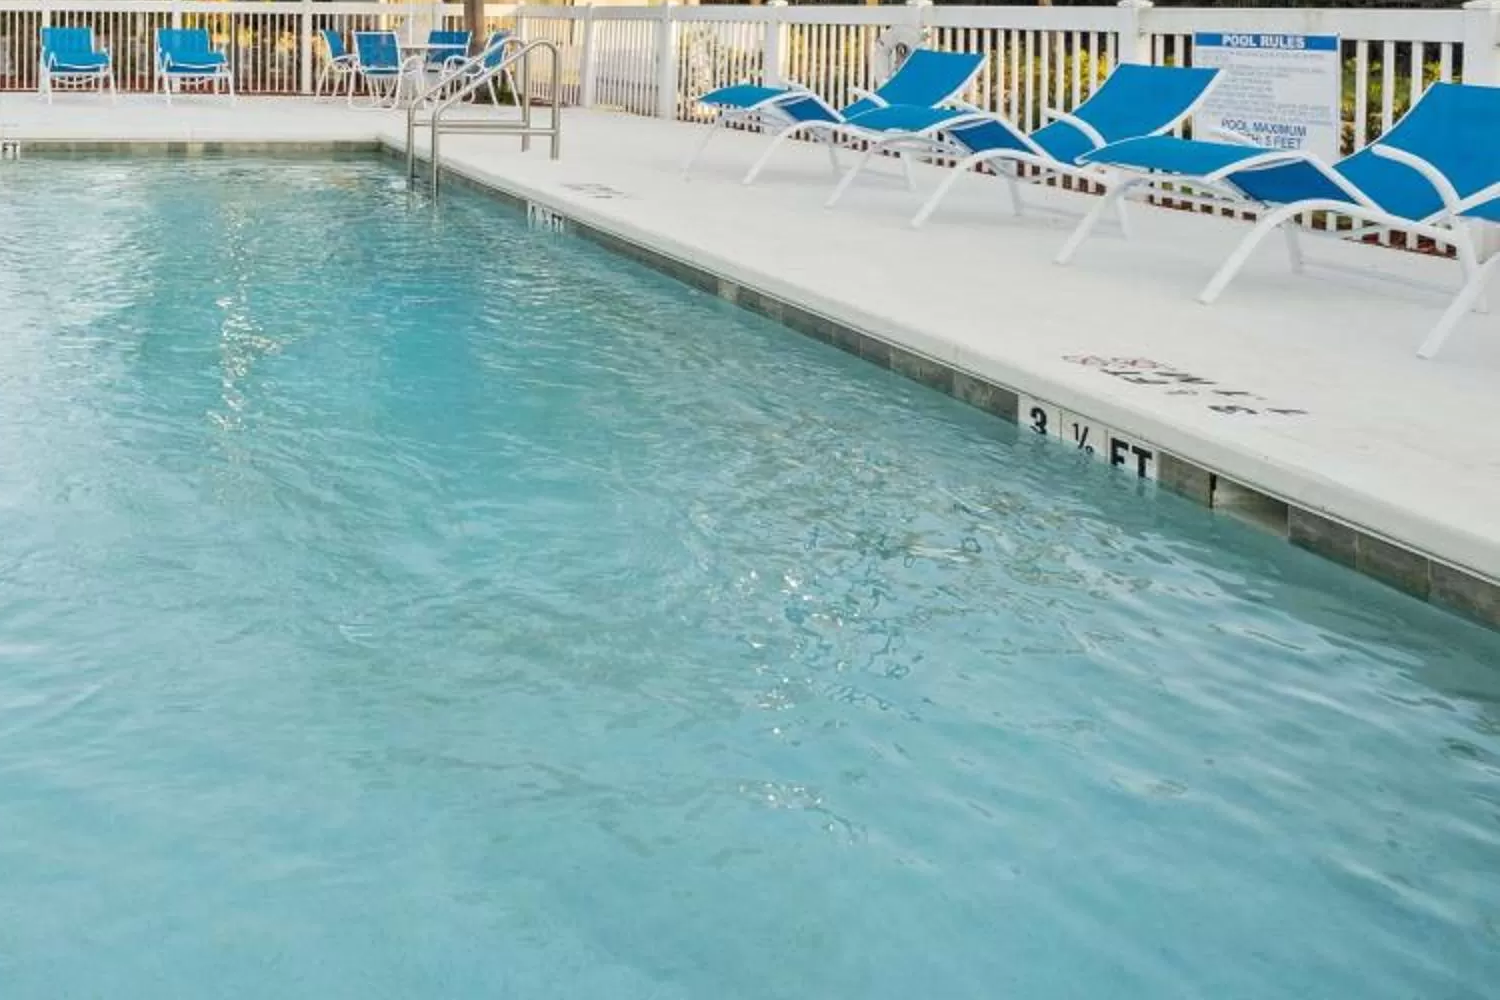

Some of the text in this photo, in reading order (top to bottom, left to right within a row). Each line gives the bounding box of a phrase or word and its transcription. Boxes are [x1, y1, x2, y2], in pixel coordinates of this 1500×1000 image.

[1222, 34, 1306, 49] POOL RULES
[1221, 119, 1247, 131] POOL
[1252, 121, 1307, 137] MAXIMUM
[1274, 137, 1304, 150] FEET
[1030, 406, 1047, 435] 3
[1110, 437, 1153, 478] FT
